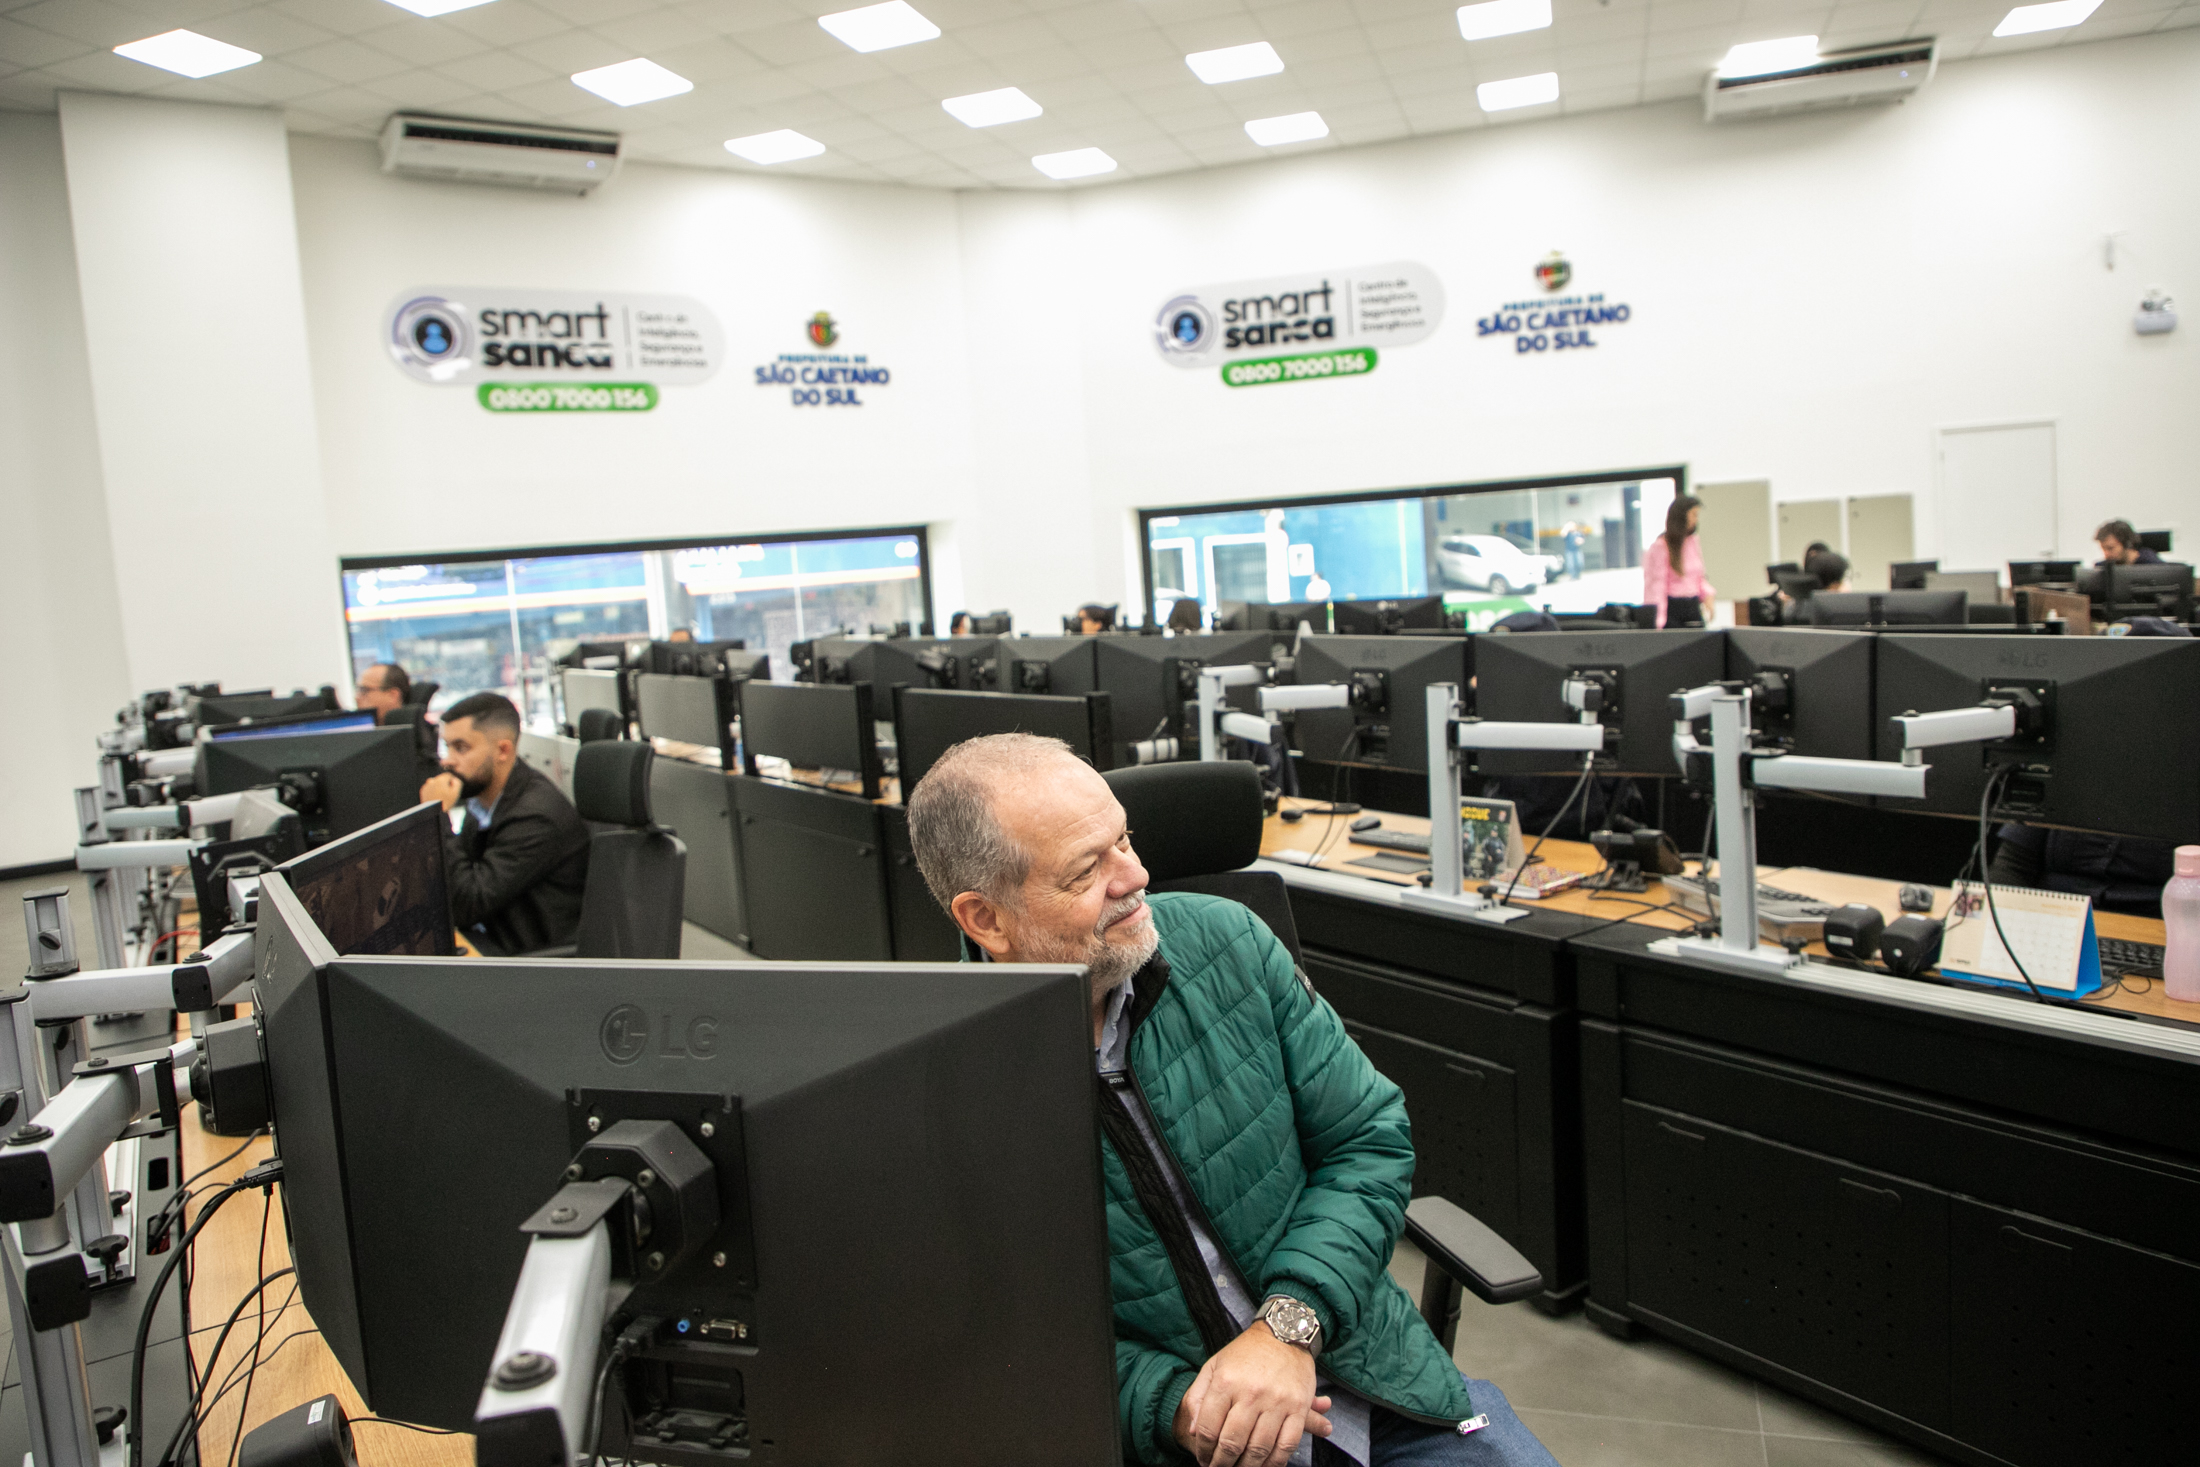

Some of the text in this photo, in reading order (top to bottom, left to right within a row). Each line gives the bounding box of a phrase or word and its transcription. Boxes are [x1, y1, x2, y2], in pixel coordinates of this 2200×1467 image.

[1224, 280, 1333, 323] smart
[480, 301, 609, 338] smart
[1225, 317, 1334, 349] sanca
[1477, 304, 1630, 336] SÃO CAETANO
[483, 341, 613, 368] sanca
[1516, 329, 1597, 353] DO SUL
[755, 362, 890, 385] SÃO CAETANO
[1228, 352, 1369, 385] 0800 7000 156
[488, 387, 650, 410] 0800 7000 156
[791, 388, 863, 406] DO SUL
[657, 1014, 718, 1060] LG
